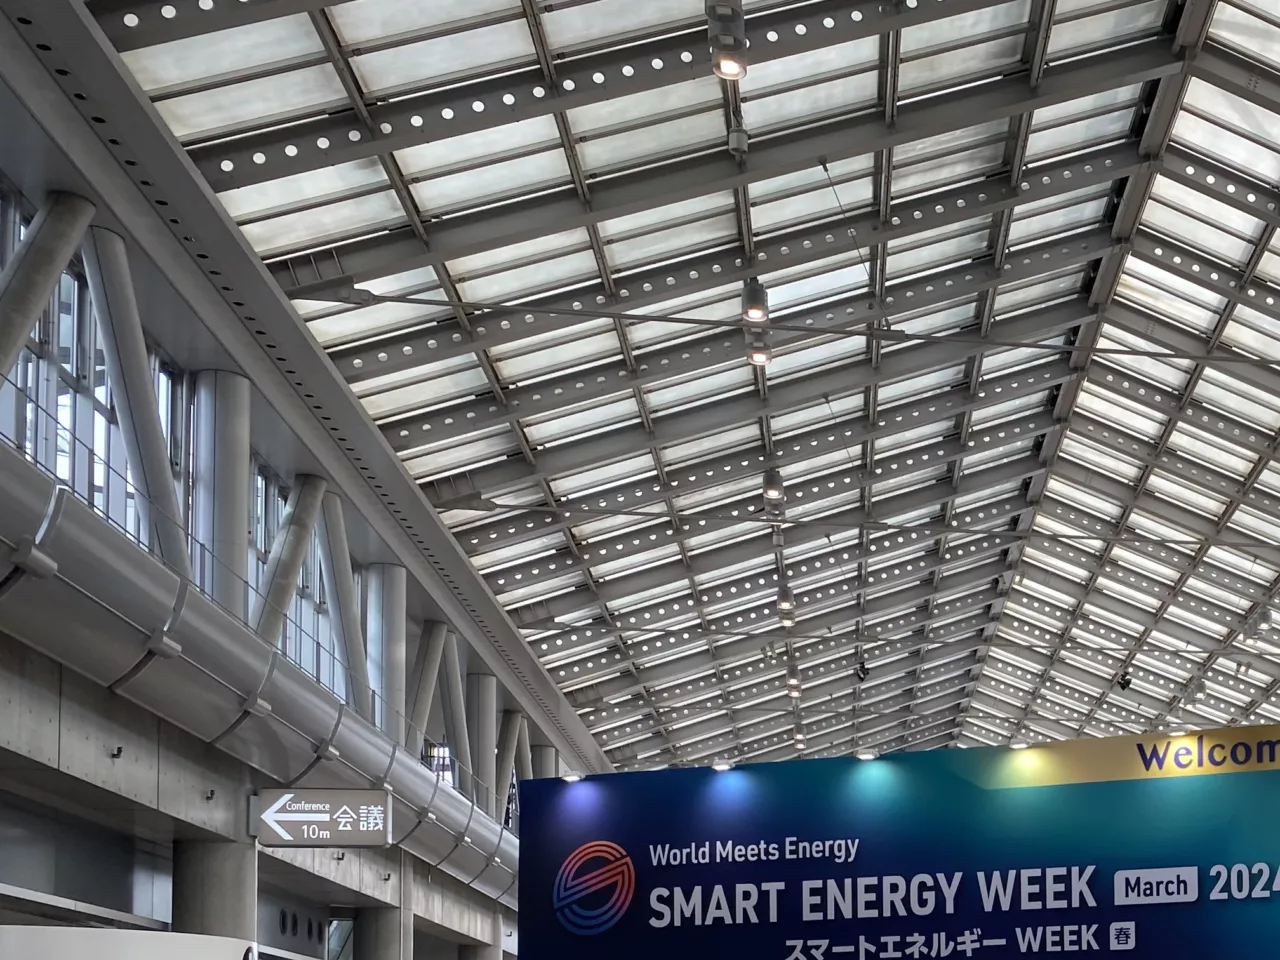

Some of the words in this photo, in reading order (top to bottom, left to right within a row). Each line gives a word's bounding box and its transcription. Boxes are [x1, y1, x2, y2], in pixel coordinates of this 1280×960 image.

[286, 801, 330, 811] Conference
[332, 804, 384, 831] 会議
[301, 824, 331, 839] 10m
[649, 841, 710, 866] World
[715, 839, 780, 863] Meets
[784, 836, 859, 863] Energy
[648, 881, 786, 928] SMART
[801, 871, 964, 922] ENERGY
[976, 865, 1098, 912] WEEK
[1123, 874, 1188, 899] March
[1015, 924, 1100, 953] WEEK
[1114, 927, 1132, 946] 春
